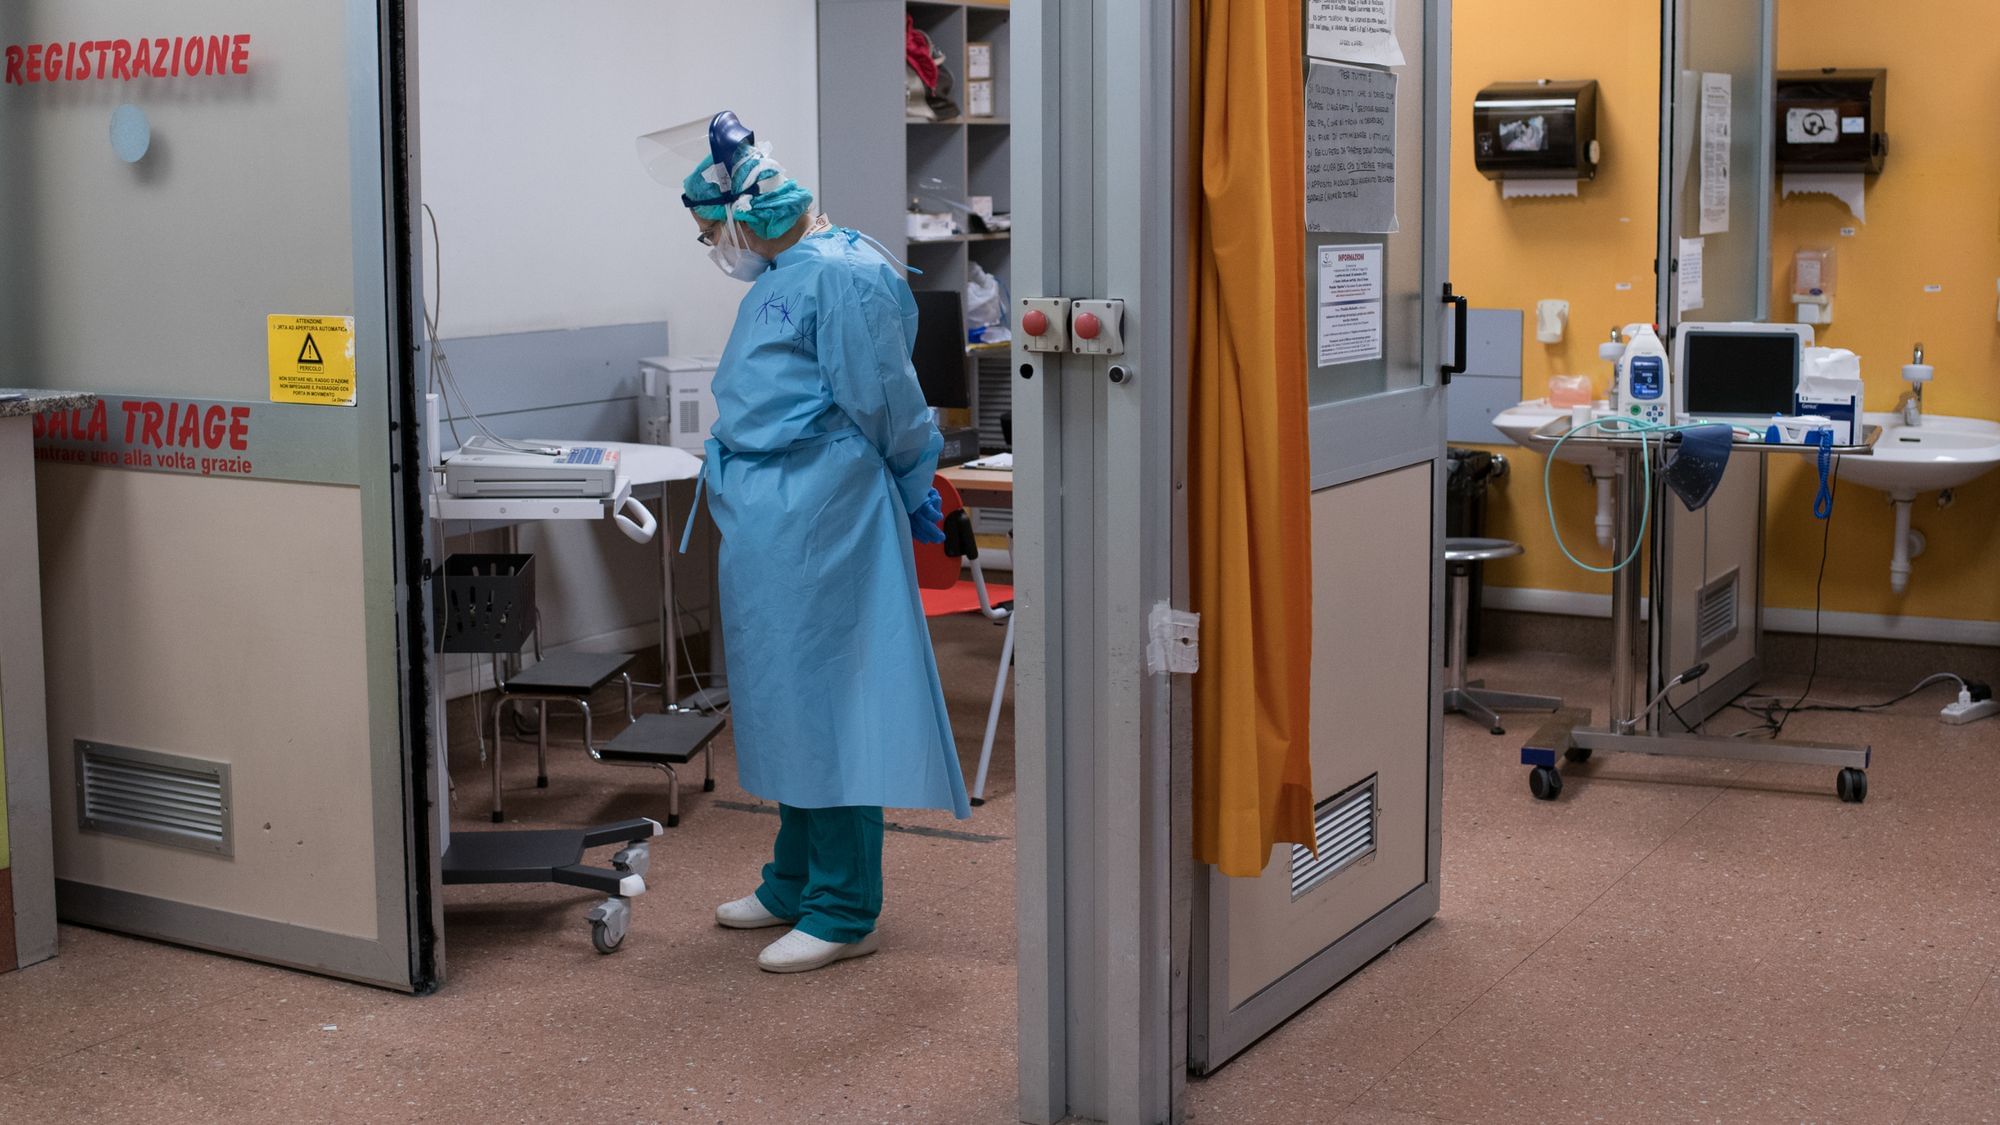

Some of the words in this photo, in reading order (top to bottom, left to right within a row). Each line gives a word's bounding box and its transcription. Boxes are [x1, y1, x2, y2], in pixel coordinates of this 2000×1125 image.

[5, 34, 251, 85] REGISTRAZIONE
[1338, 253, 1364, 262] INFORMAZIONI
[122, 400, 250, 450] TRIAGE
[92, 450, 118, 465] uno
[124, 449, 152, 467] alla
[157, 451, 196, 471] volta
[201, 455, 252, 476] grazie
